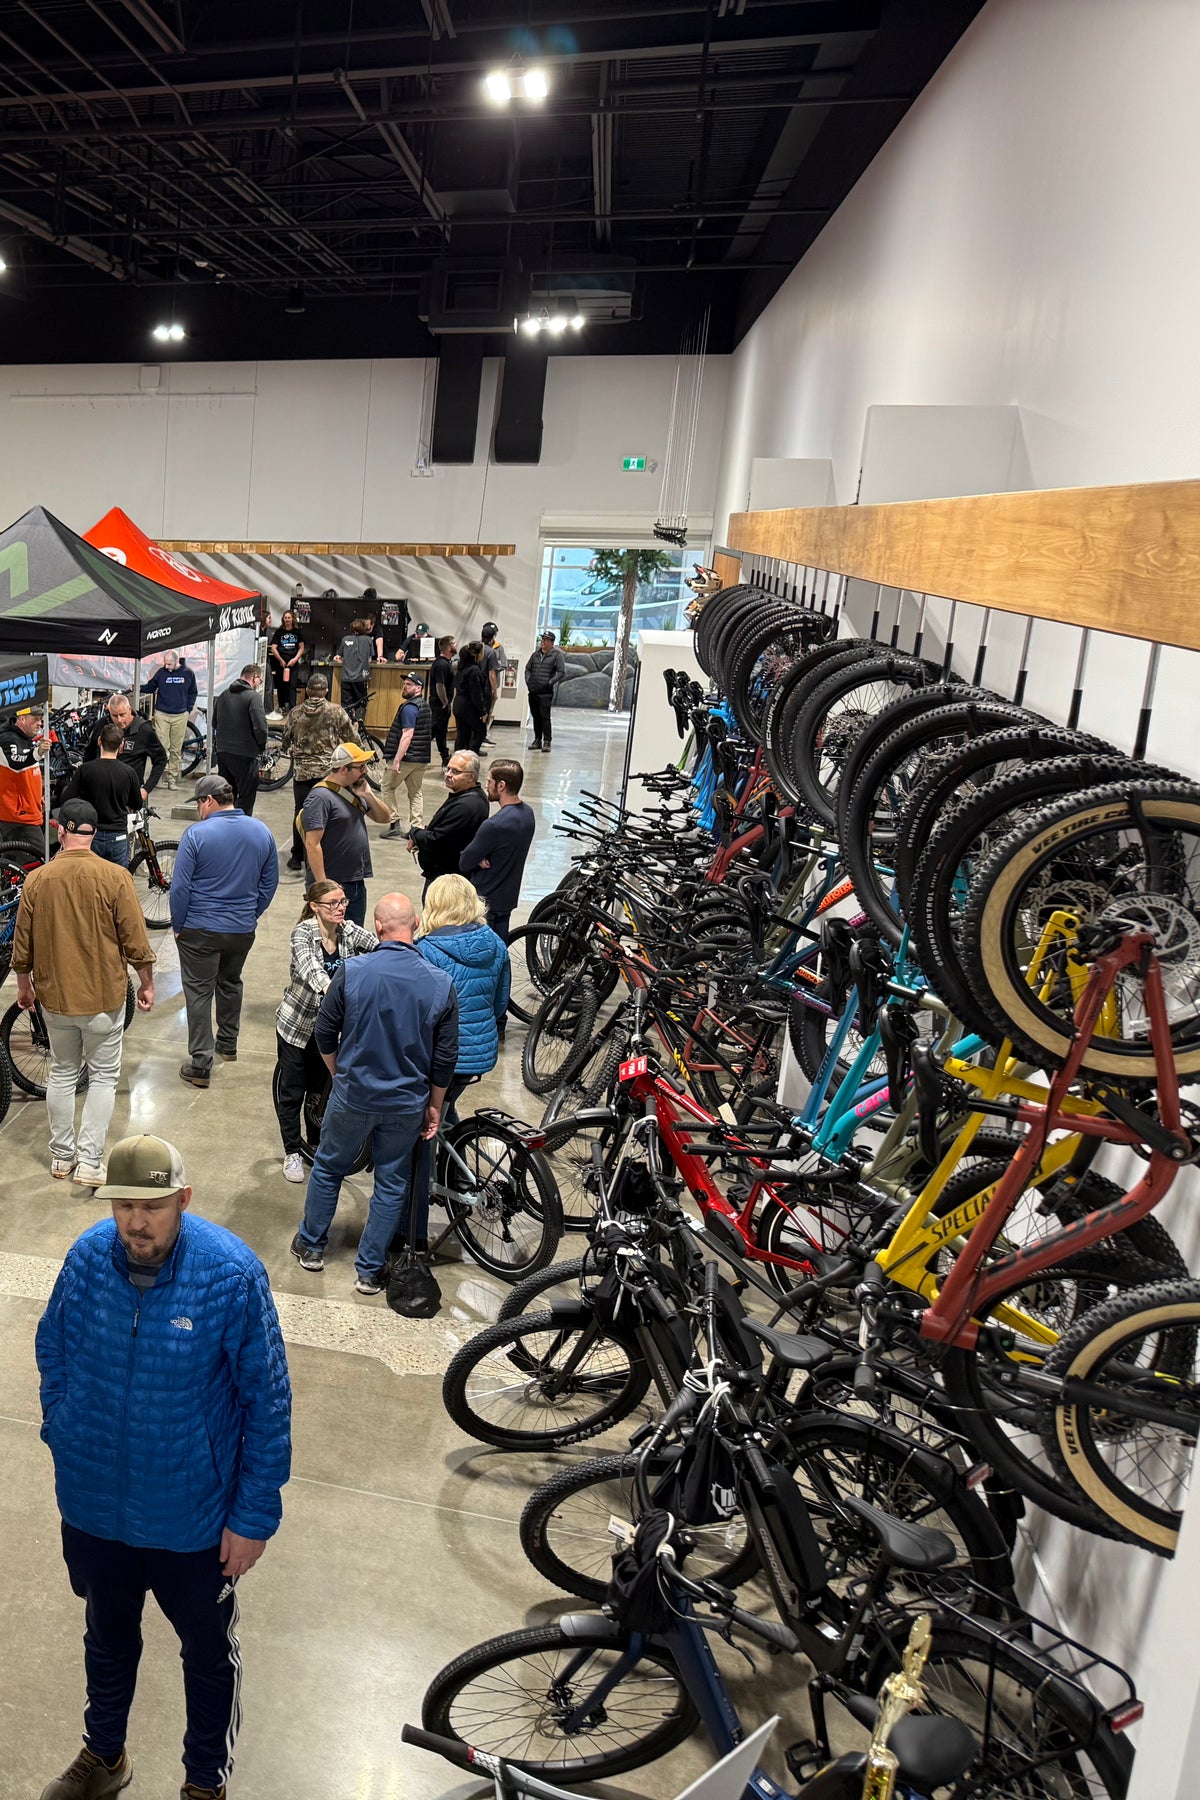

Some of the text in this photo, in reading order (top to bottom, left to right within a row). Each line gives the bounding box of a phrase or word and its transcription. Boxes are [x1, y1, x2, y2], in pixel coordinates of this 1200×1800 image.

[146, 626, 172, 640] NORCO
[766, 685, 785, 750] SCHWALBE
[906, 817, 920, 848] GROUND
[916, 788, 937, 817] CONTROL
[1032, 832, 1060, 854] VEE
[1062, 814, 1101, 835] TIRE
[926, 891, 935, 930] CONTROL
[926, 931, 944, 967] GROUND
[149, 1170, 169, 1184] FOX
[553, 1415, 615, 1448] KENDA
[1063, 1428, 1079, 1456] VEE
